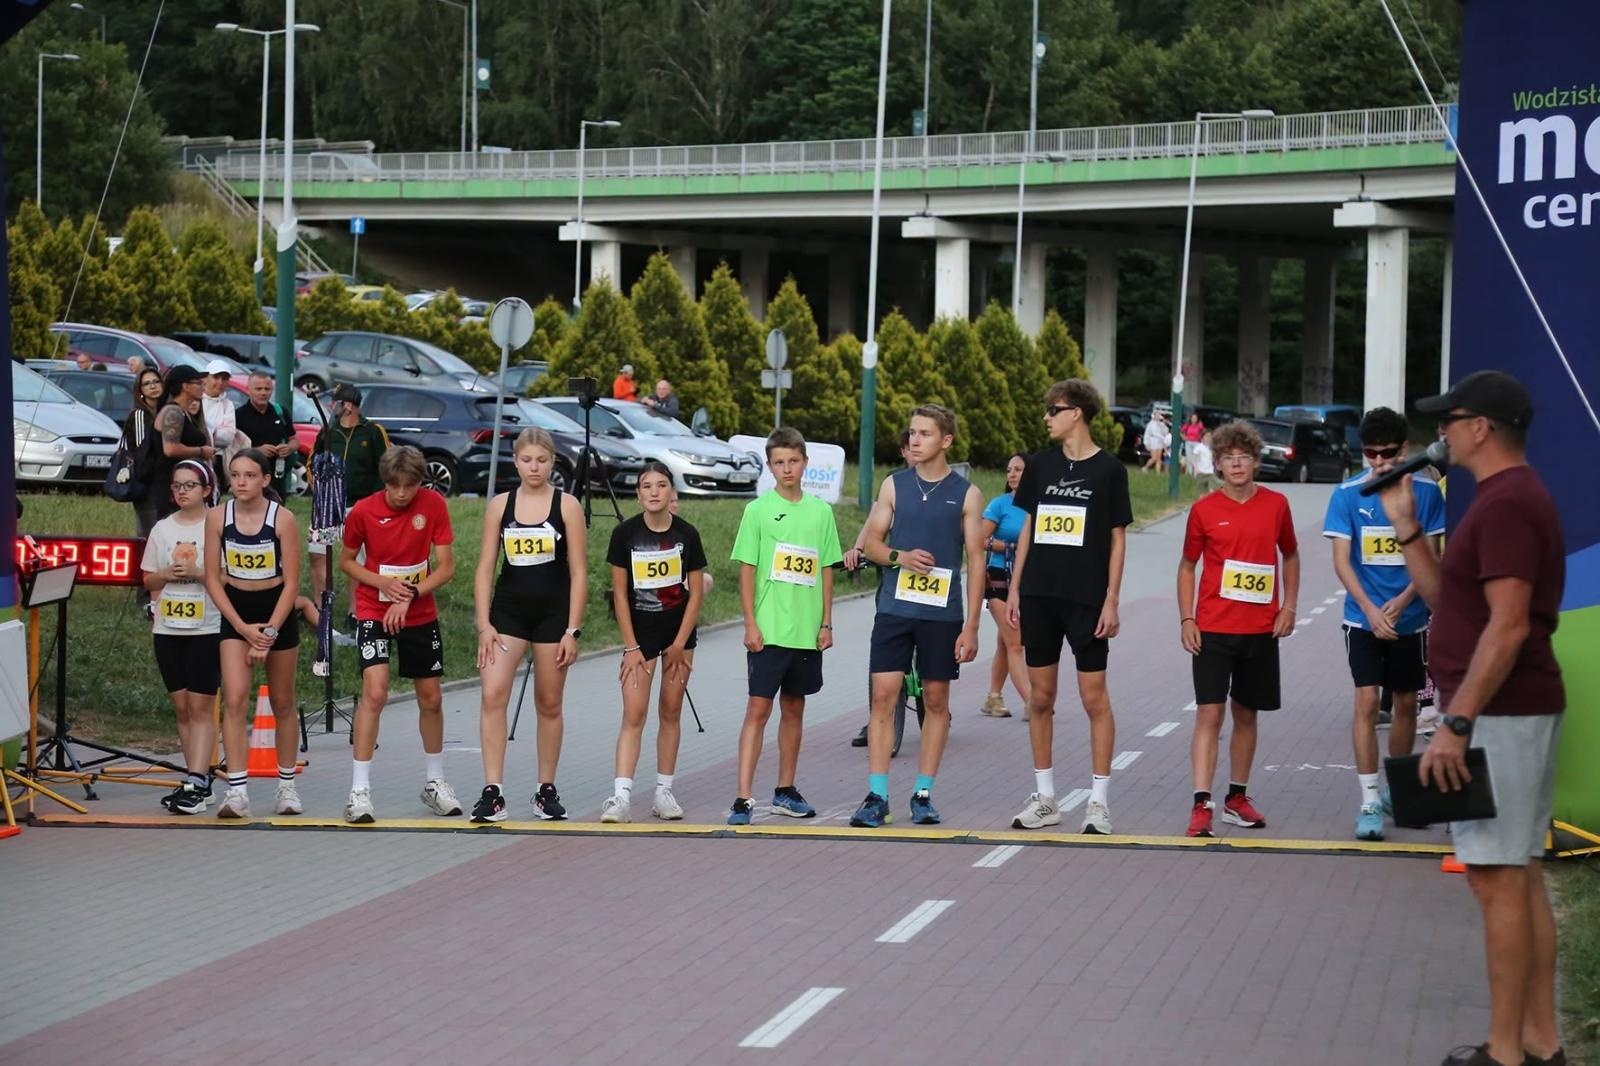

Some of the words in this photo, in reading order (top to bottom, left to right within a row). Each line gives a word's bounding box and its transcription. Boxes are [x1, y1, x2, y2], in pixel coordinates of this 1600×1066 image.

[1513, 83, 1600, 111] Wodzisł
[1044, 516, 1075, 533] 130
[514, 538, 546, 555] 131
[1373, 537, 1402, 554] 13
[234, 553, 267, 569] 132
[647, 561, 669, 578] 50
[783, 555, 814, 574] 133
[907, 574, 940, 594] 134
[1233, 572, 1266, 591] 136
[166, 601, 196, 617] 143
